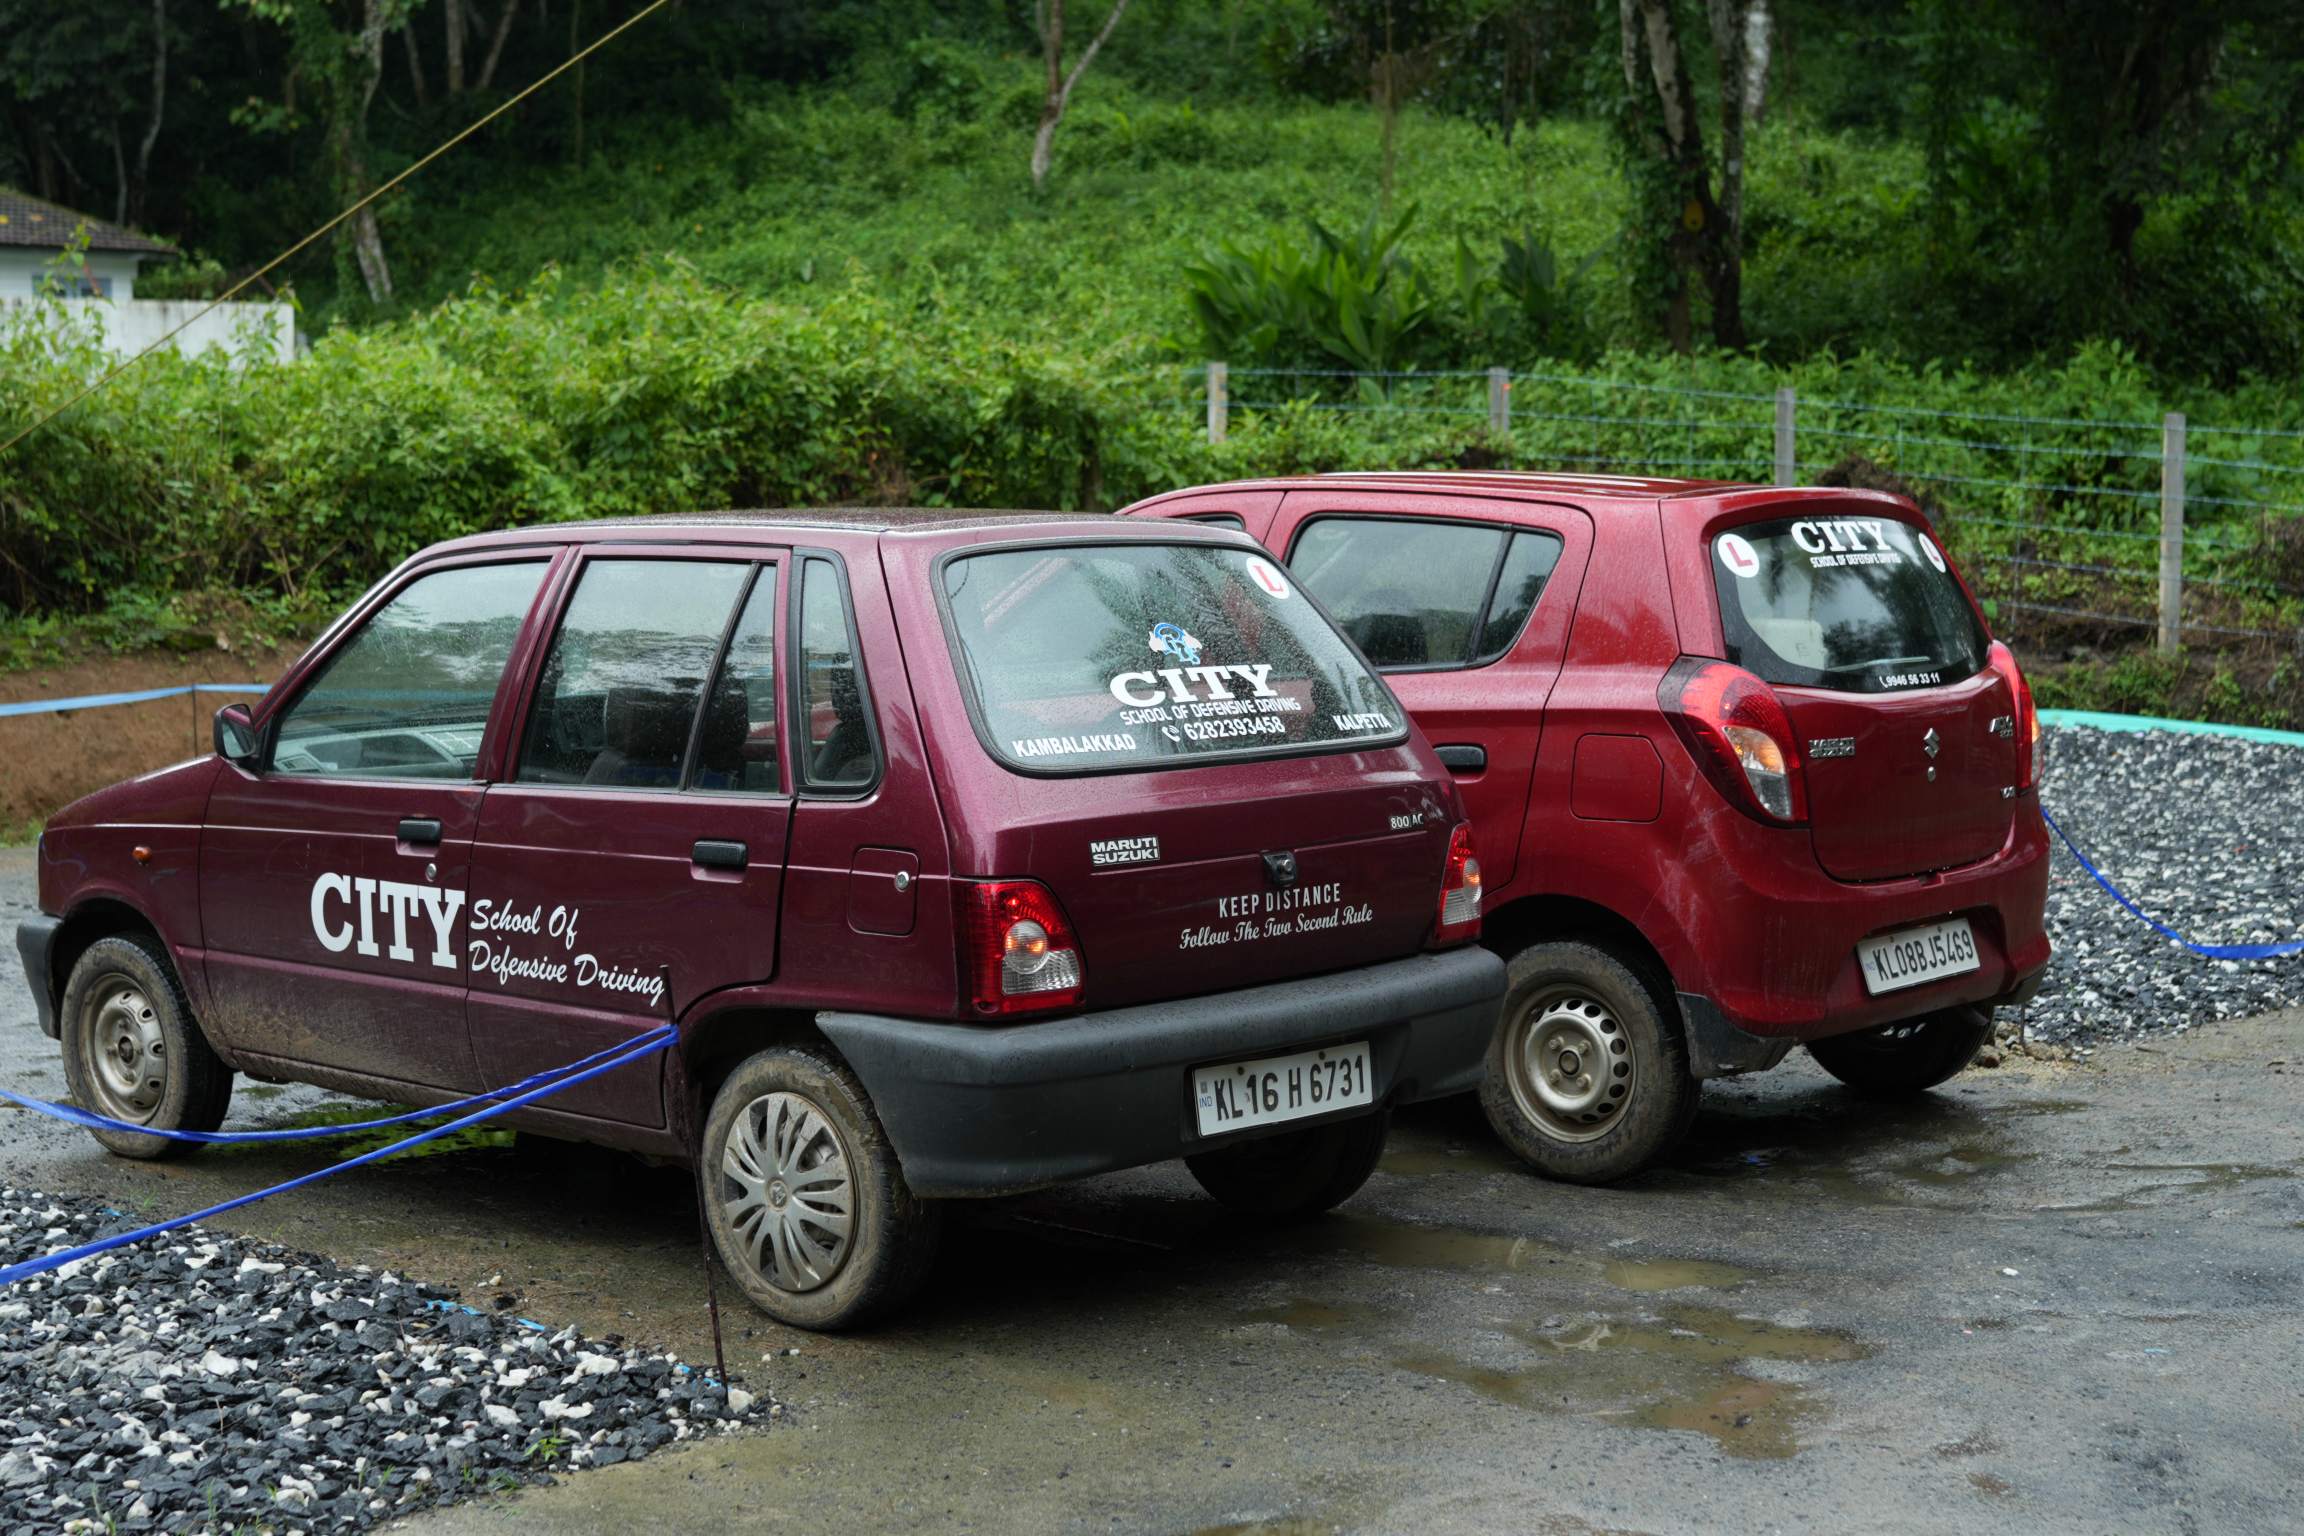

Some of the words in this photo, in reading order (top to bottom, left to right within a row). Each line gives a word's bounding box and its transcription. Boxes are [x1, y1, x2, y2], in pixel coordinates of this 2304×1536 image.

[1791, 521, 1891, 554] CITY
[1922, 540, 1939, 562] L
[1726, 542, 1753, 567] L
[1810, 555, 1838, 568] SCHOOL
[1835, 554, 1846, 566] OF
[1252, 564, 1284, 592] L
[1110, 664, 1279, 708] CITY
[1886, 674, 1907, 687] 9946
[1919, 672, 1930, 684] 33
[1931, 671, 1940, 683] 11
[1119, 706, 1172, 726] SCHOOL
[1171, 704, 1190, 720] OF
[1189, 699, 1257, 718] DEFENSIVE
[1255, 697, 1302, 713] DRIVING
[1332, 712, 1393, 731] KALPETTA
[1183, 715, 1286, 741] 6282393458
[1012, 733, 1137, 758] KAMBALAKKAD
[1390, 815, 1410, 829] 800
[1412, 813, 1424, 825] AC
[1090, 837, 1157, 854] MARUTI
[1092, 848, 1159, 866] SUZUKI
[1219, 892, 1260, 919] KEEP
[1265, 882, 1341, 913] DISTANCE
[310, 872, 466, 970] CITY
[470, 899, 542, 936] School
[548, 905, 579, 950] Of
[1179, 927, 1231, 950] Follow
[1234, 920, 1260, 942] The
[1263, 917, 1293, 938] Two
[1295, 909, 1339, 934] Second
[1341, 903, 1373, 926] Rule
[1872, 929, 1974, 981] KL08BJ5469
[469, 939, 568, 986] Defensive
[574, 953, 665, 1007] Driving
[1214, 1078, 1244, 1121] KL
[1246, 1072, 1280, 1115] 16
[1288, 1067, 1303, 1109] H
[1309, 1054, 1365, 1104] 6731
